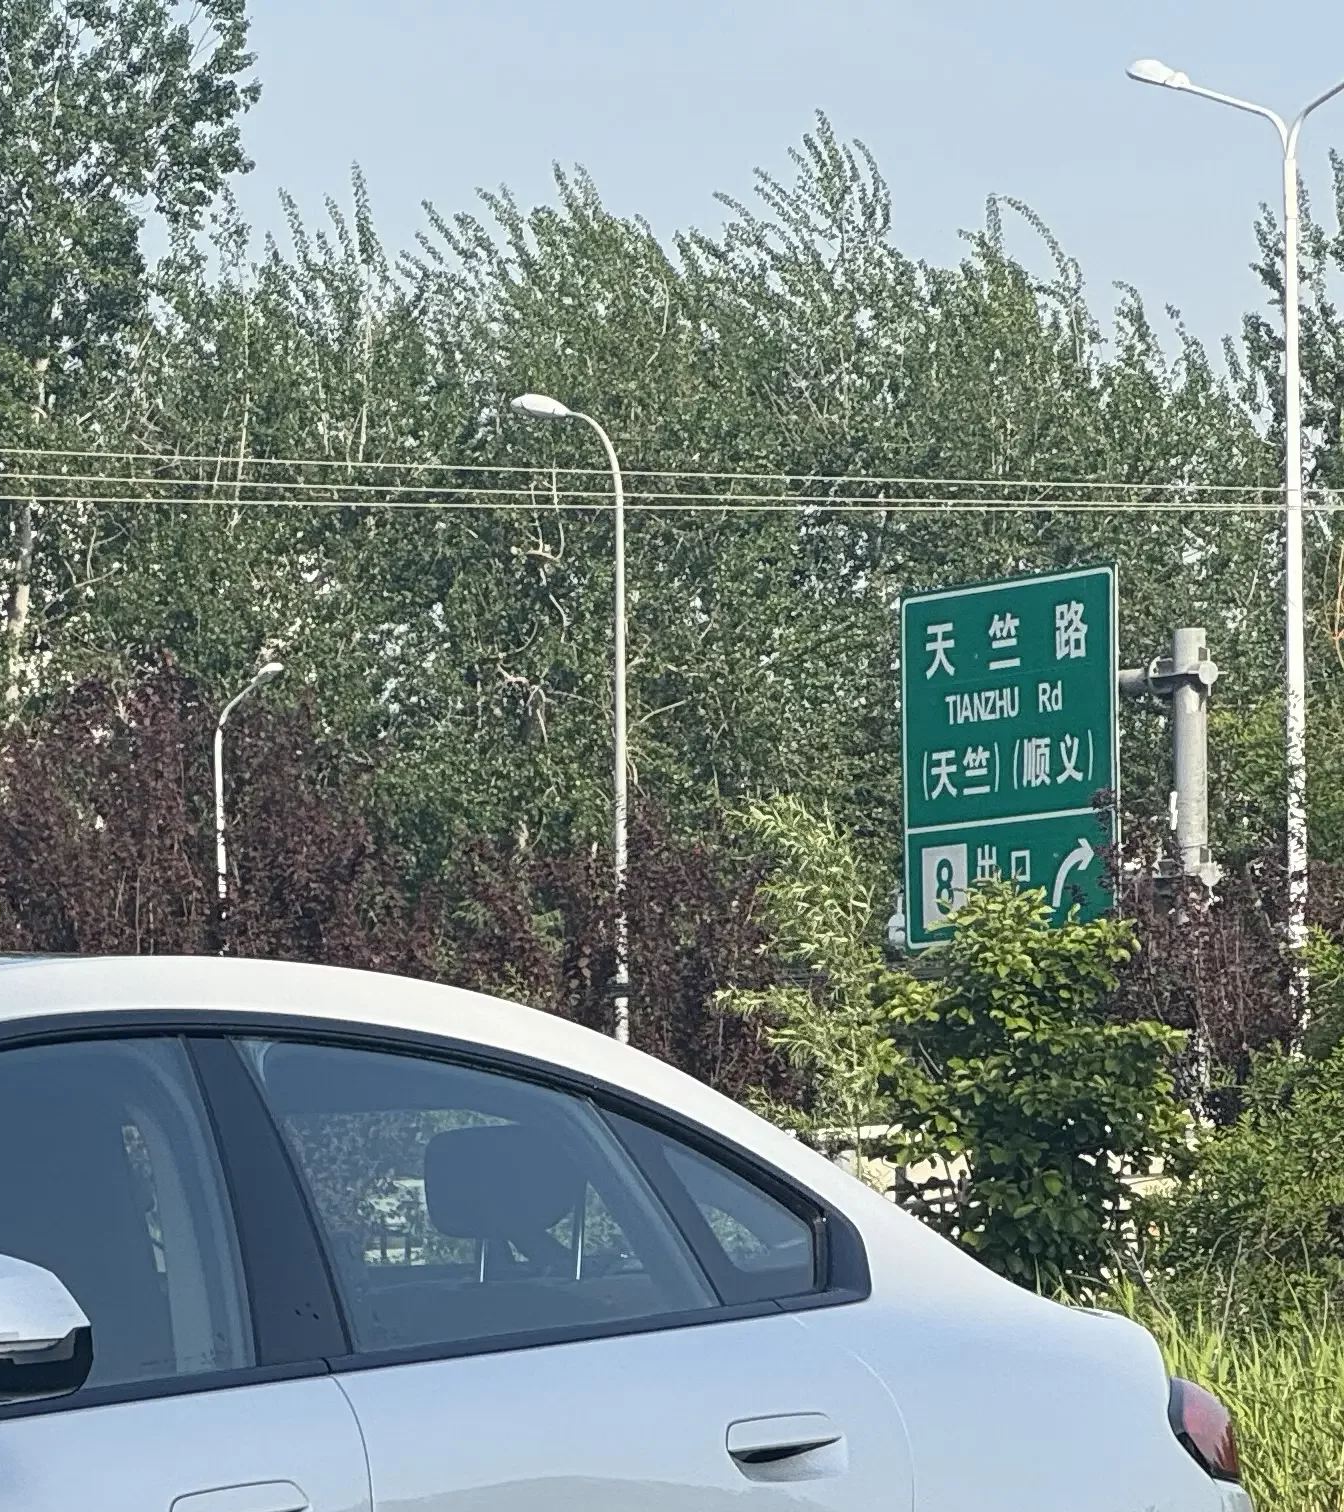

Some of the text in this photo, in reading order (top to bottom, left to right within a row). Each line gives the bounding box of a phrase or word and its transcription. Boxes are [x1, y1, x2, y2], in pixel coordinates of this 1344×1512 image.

[924, 600, 1089, 680] 天竺路
[945, 680, 1063, 725] TIANZHU Rd
[922, 729, 1094, 801] (天竺) (顺义)
[935, 844, 1032, 917] 8 出口
